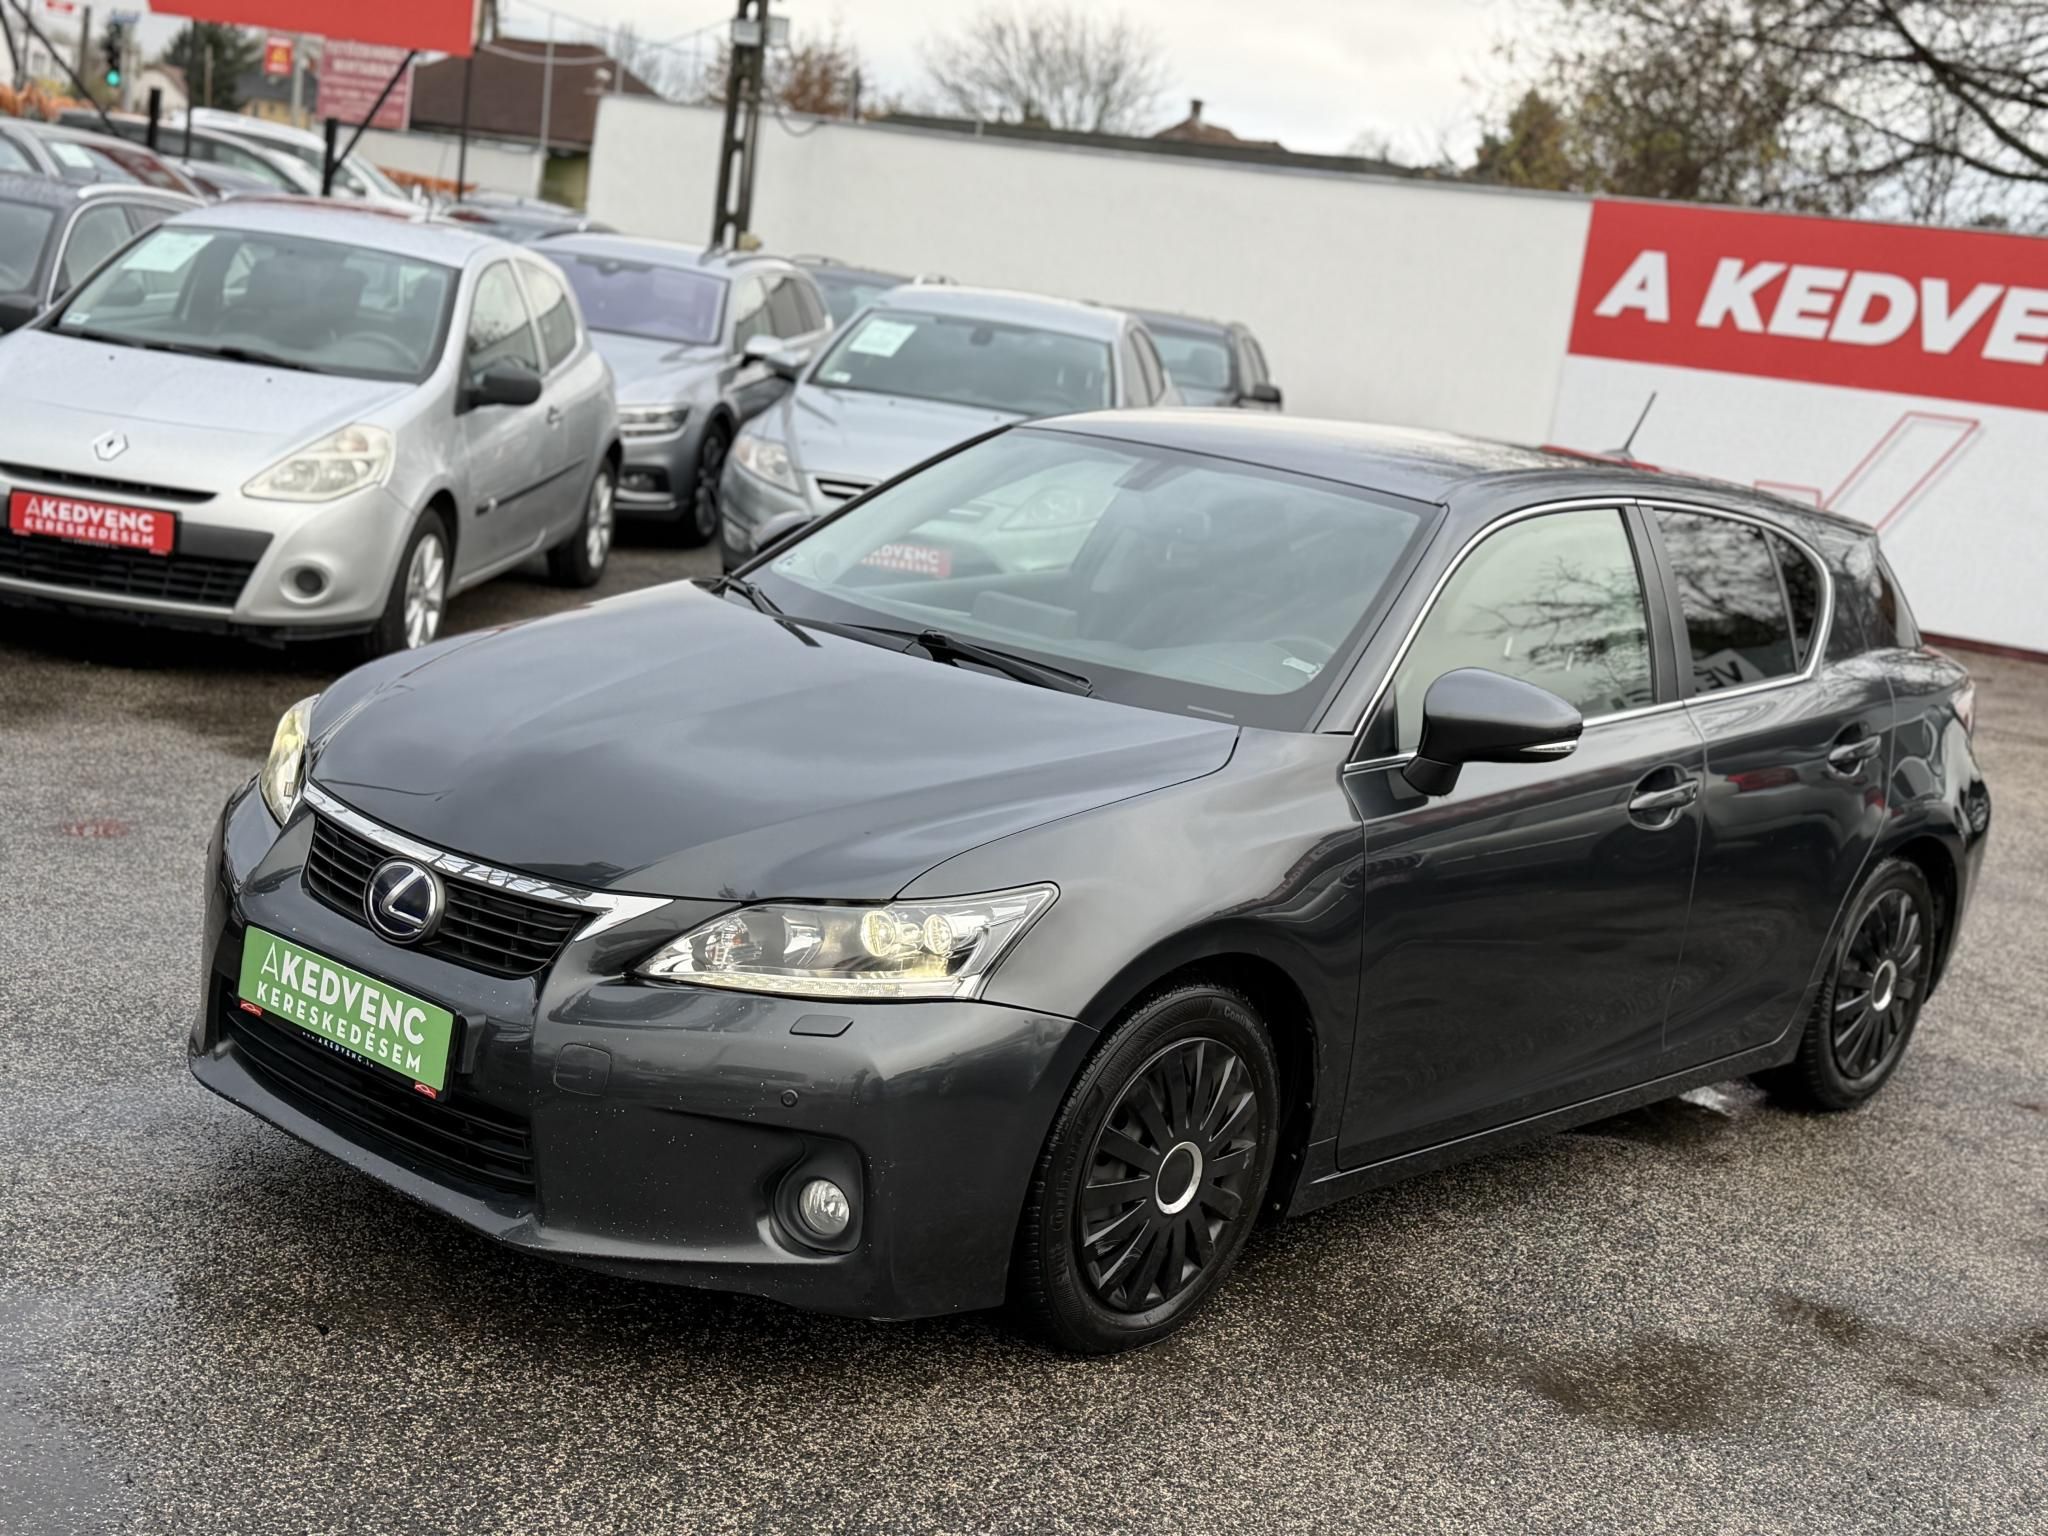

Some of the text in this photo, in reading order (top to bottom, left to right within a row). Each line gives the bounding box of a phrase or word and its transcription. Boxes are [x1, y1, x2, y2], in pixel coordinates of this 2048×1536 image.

[1594, 249, 2048, 366] A KEDVE
[25, 496, 155, 533] AKEDVENC
[256, 981, 422, 1073] KERESKEDÉSEM
[260, 941, 427, 1045] AKEDVENC
